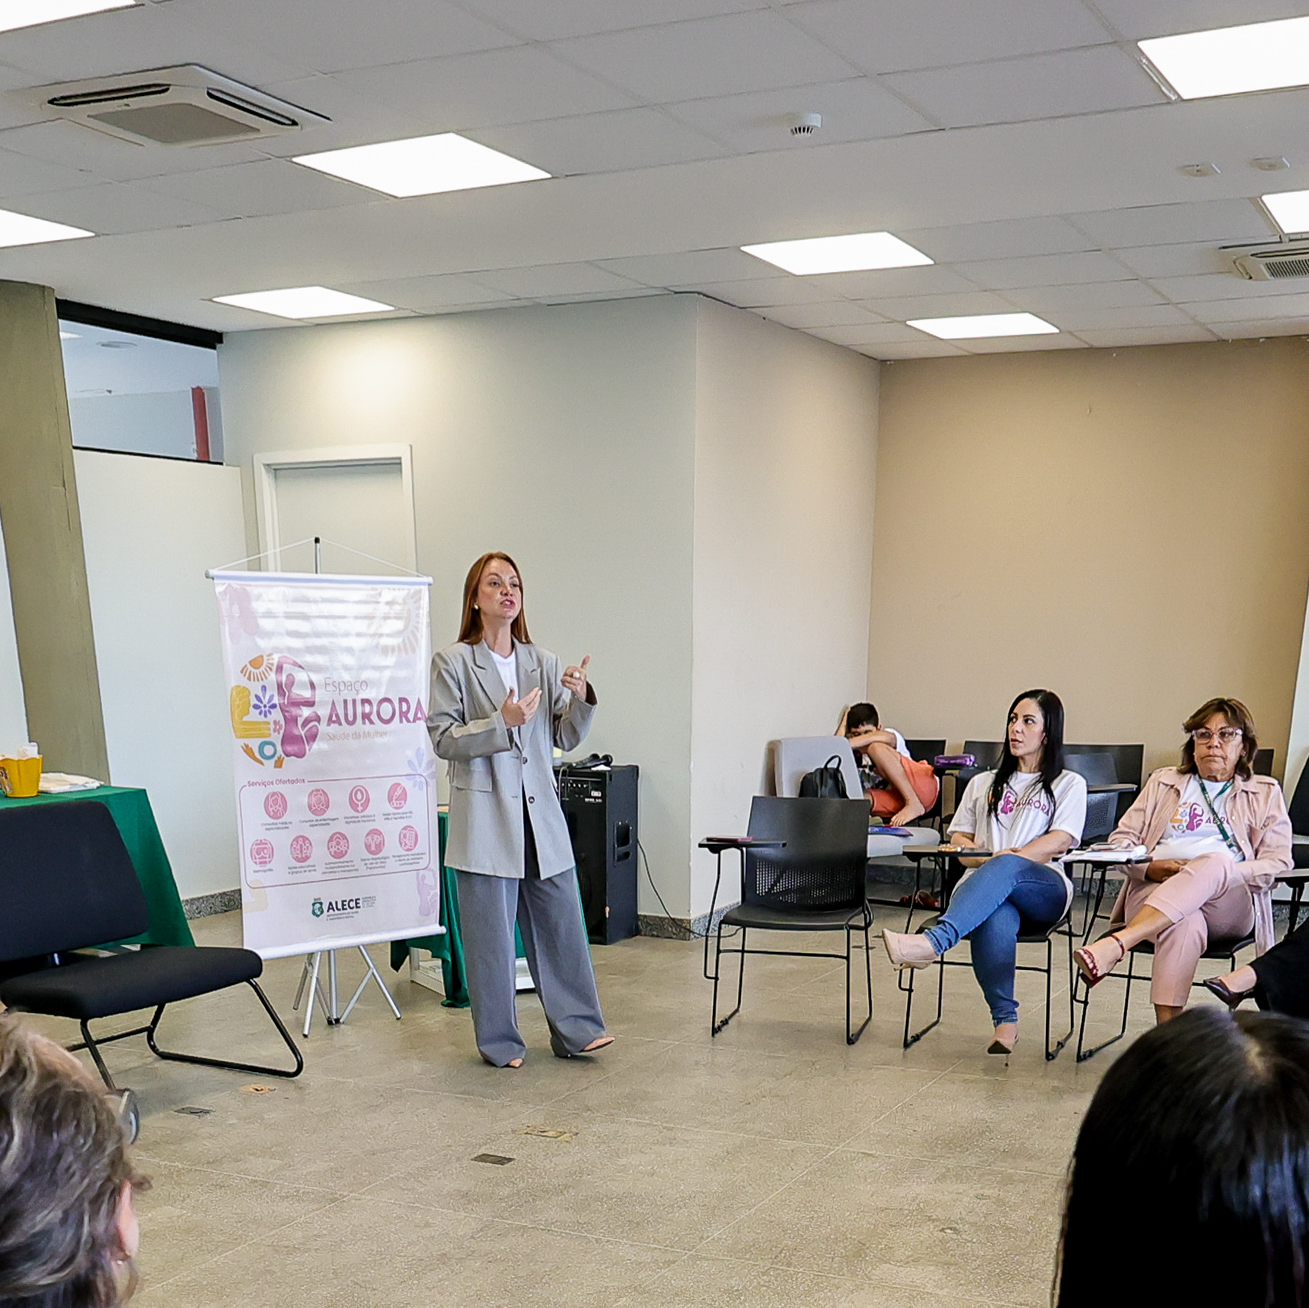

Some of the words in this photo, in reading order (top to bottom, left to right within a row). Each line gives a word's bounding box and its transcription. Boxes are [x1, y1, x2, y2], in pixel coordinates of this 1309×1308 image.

[324, 677, 368, 695] Espaço
[326, 697, 428, 727] AURORA
[326, 731, 351, 741] Saúde
[362, 730, 388, 740] Mulher
[247, 779, 274, 788] Serviços
[275, 777, 305, 786] Ofertados
[327, 897, 361, 913] ALECE
